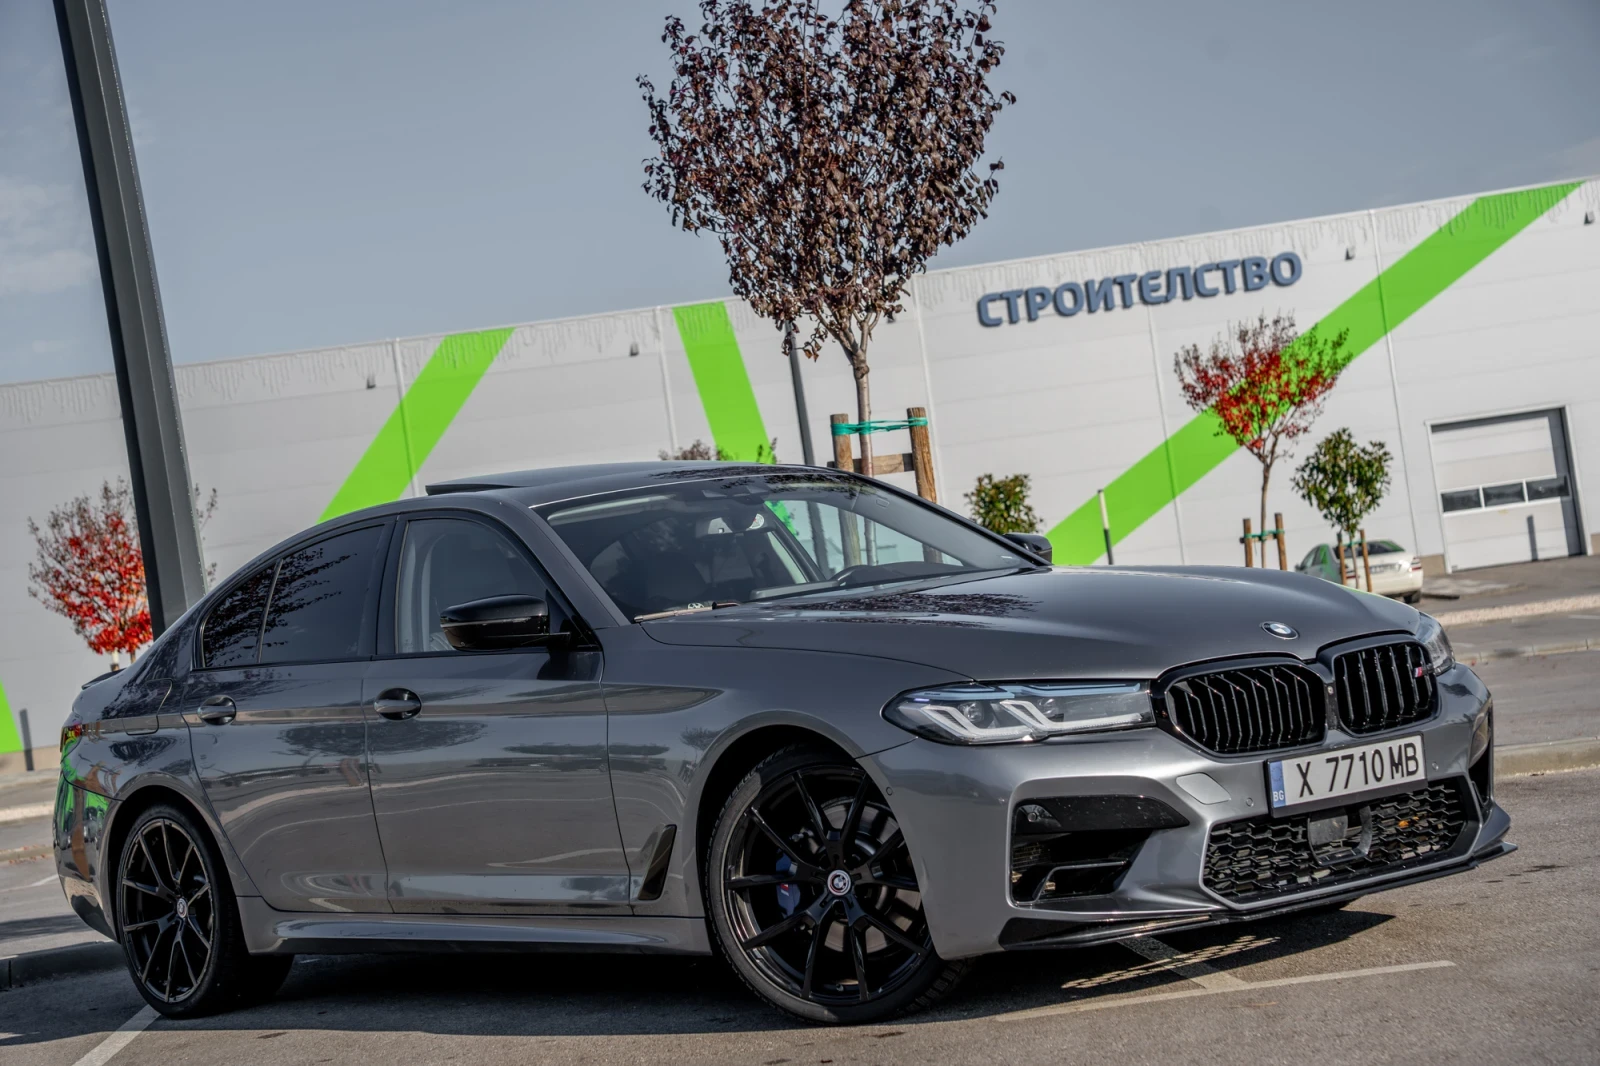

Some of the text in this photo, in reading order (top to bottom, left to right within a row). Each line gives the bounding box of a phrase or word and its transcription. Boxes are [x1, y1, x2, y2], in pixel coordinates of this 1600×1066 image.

[977, 252, 1302, 327] СТРОИТЕЛСТВО
[1325, 748, 1385, 792] 7710
[1272, 790, 1285, 802] BG
